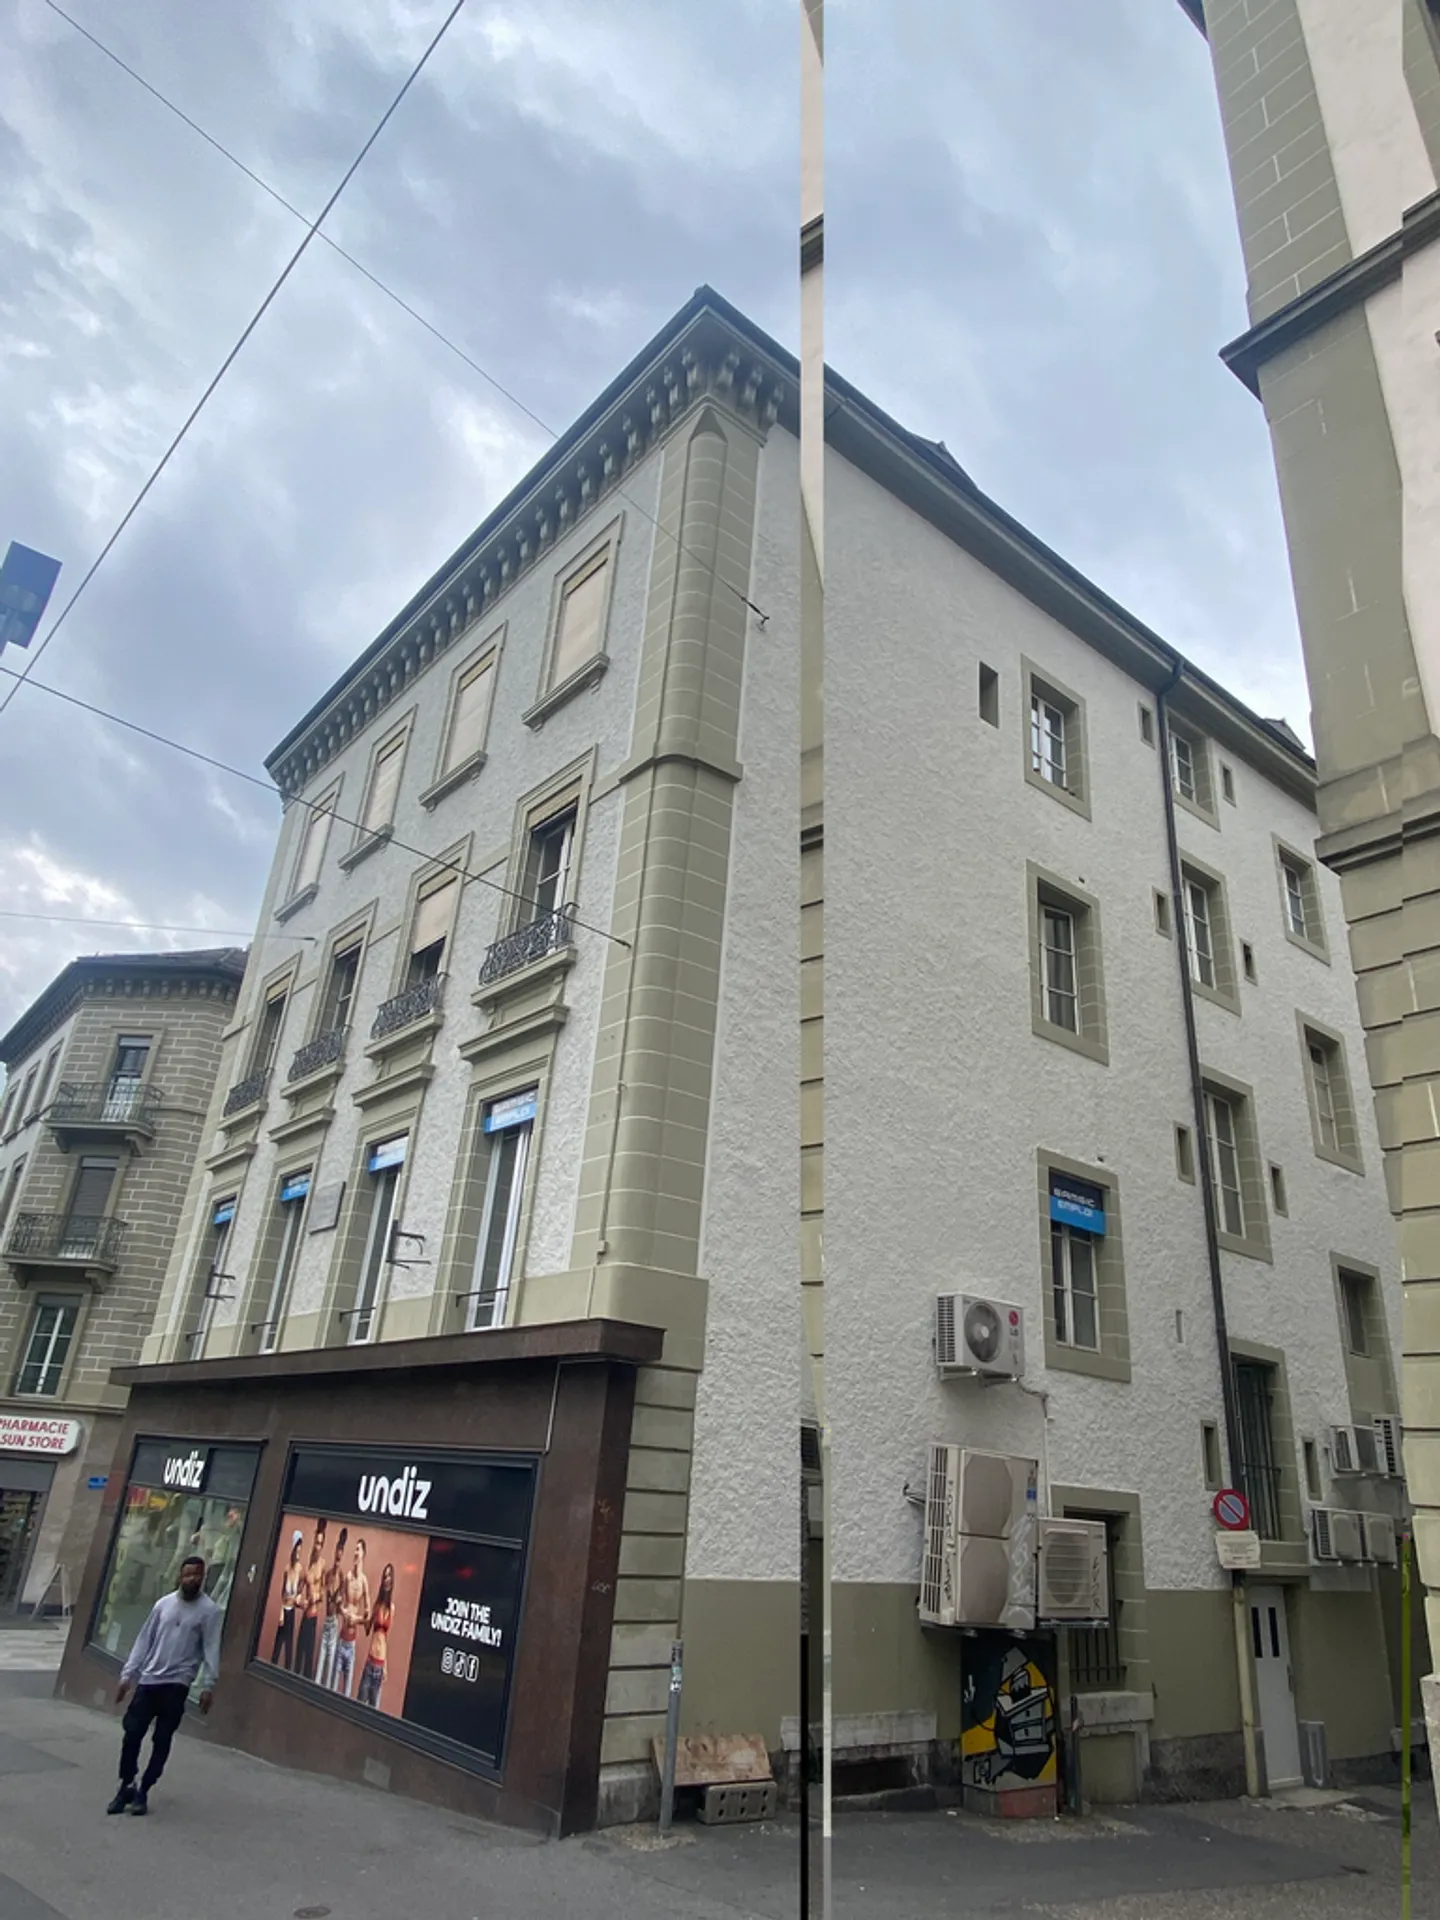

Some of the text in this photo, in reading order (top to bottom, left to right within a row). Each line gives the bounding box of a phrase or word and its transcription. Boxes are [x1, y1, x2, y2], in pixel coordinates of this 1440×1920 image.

[0, 1434, 66, 1449] SUN STORE
[164, 1450, 205, 1488] undiz
[358, 1466, 432, 1519] undiz
[445, 1597, 491, 1624] JOIN THE
[431, 1611, 502, 1648] UNDIZ FAMILY!
